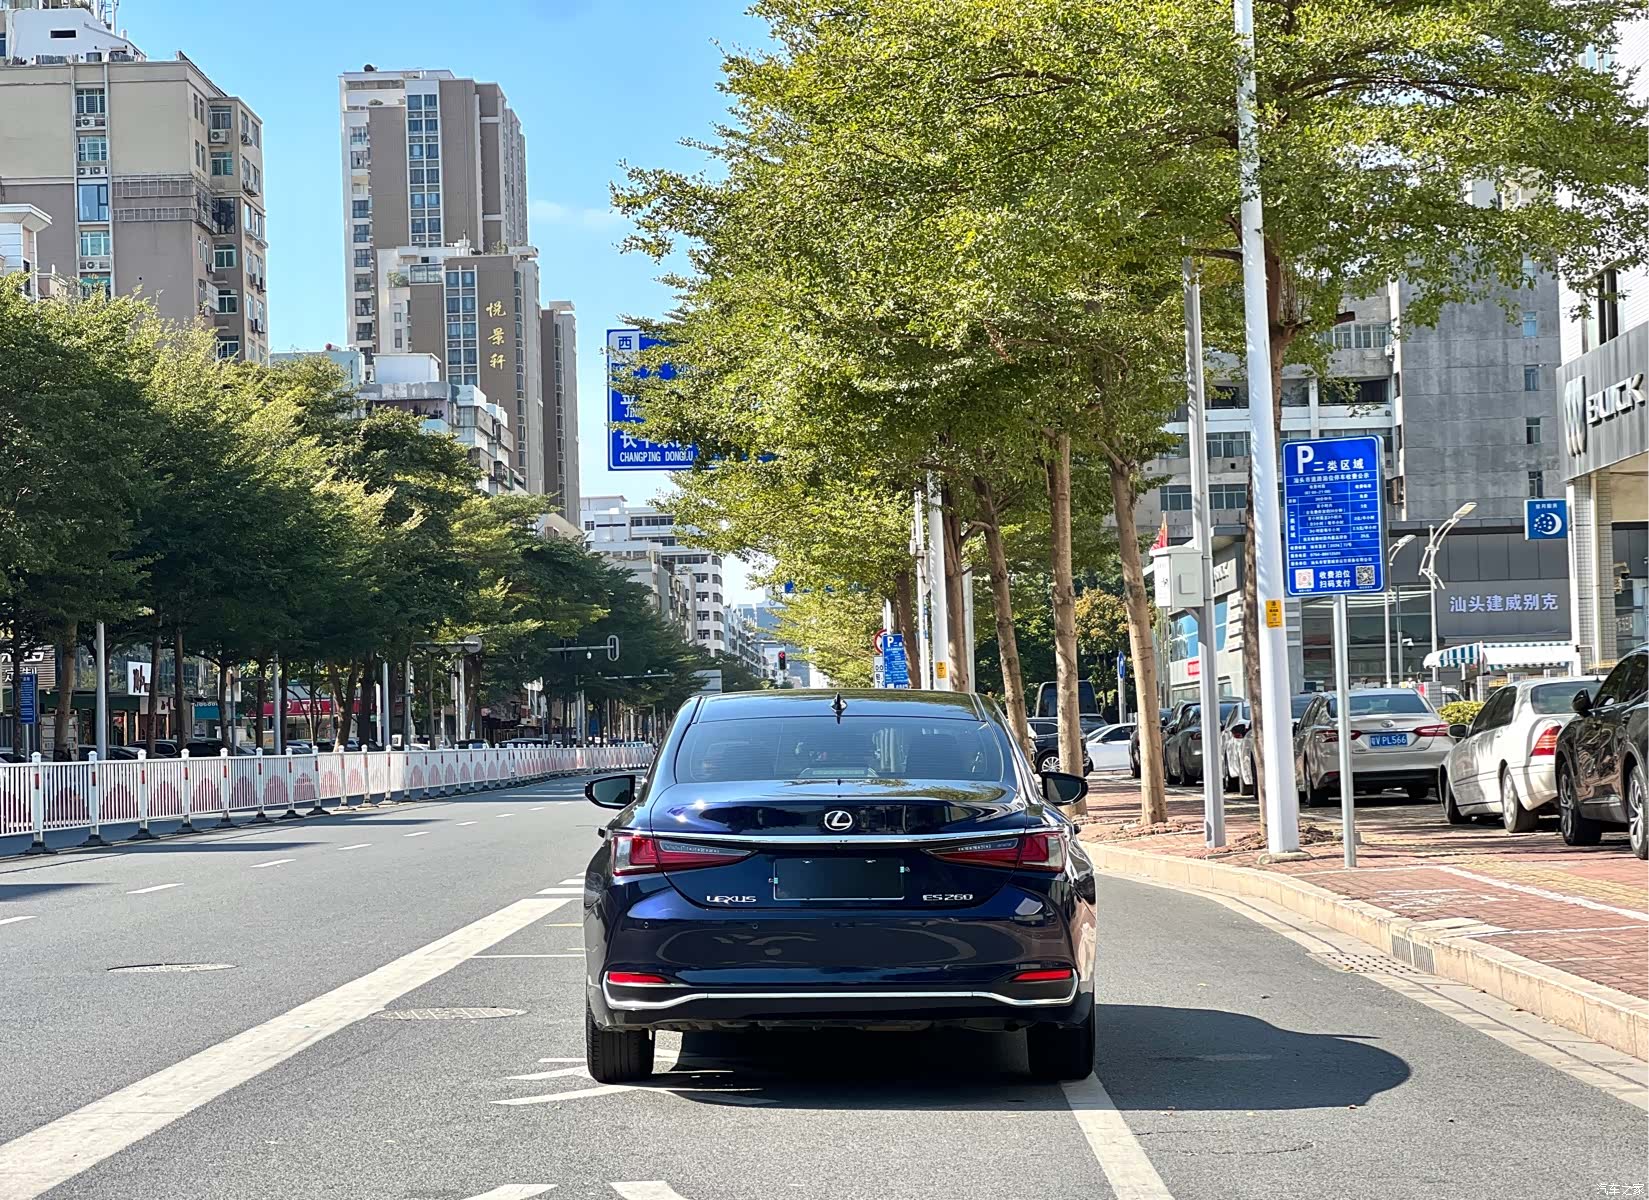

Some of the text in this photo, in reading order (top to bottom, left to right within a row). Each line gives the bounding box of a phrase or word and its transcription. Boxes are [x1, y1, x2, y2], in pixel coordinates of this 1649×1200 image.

[618, 336, 632, 349] 西
[1586, 373, 1646, 425] BUICK
[620, 451, 661, 462] CHANGPING
[1297, 445, 1314, 474] P
[1313, 458, 1365, 472] 二类区域
[1319, 570, 1351, 579] 收费泊位
[1319, 579, 1351, 588] 扫码支付
[1450, 593, 1558, 612] 汕头建威别克
[706, 895, 757, 904] LEXUS
[922, 893, 974, 901] ES 260
